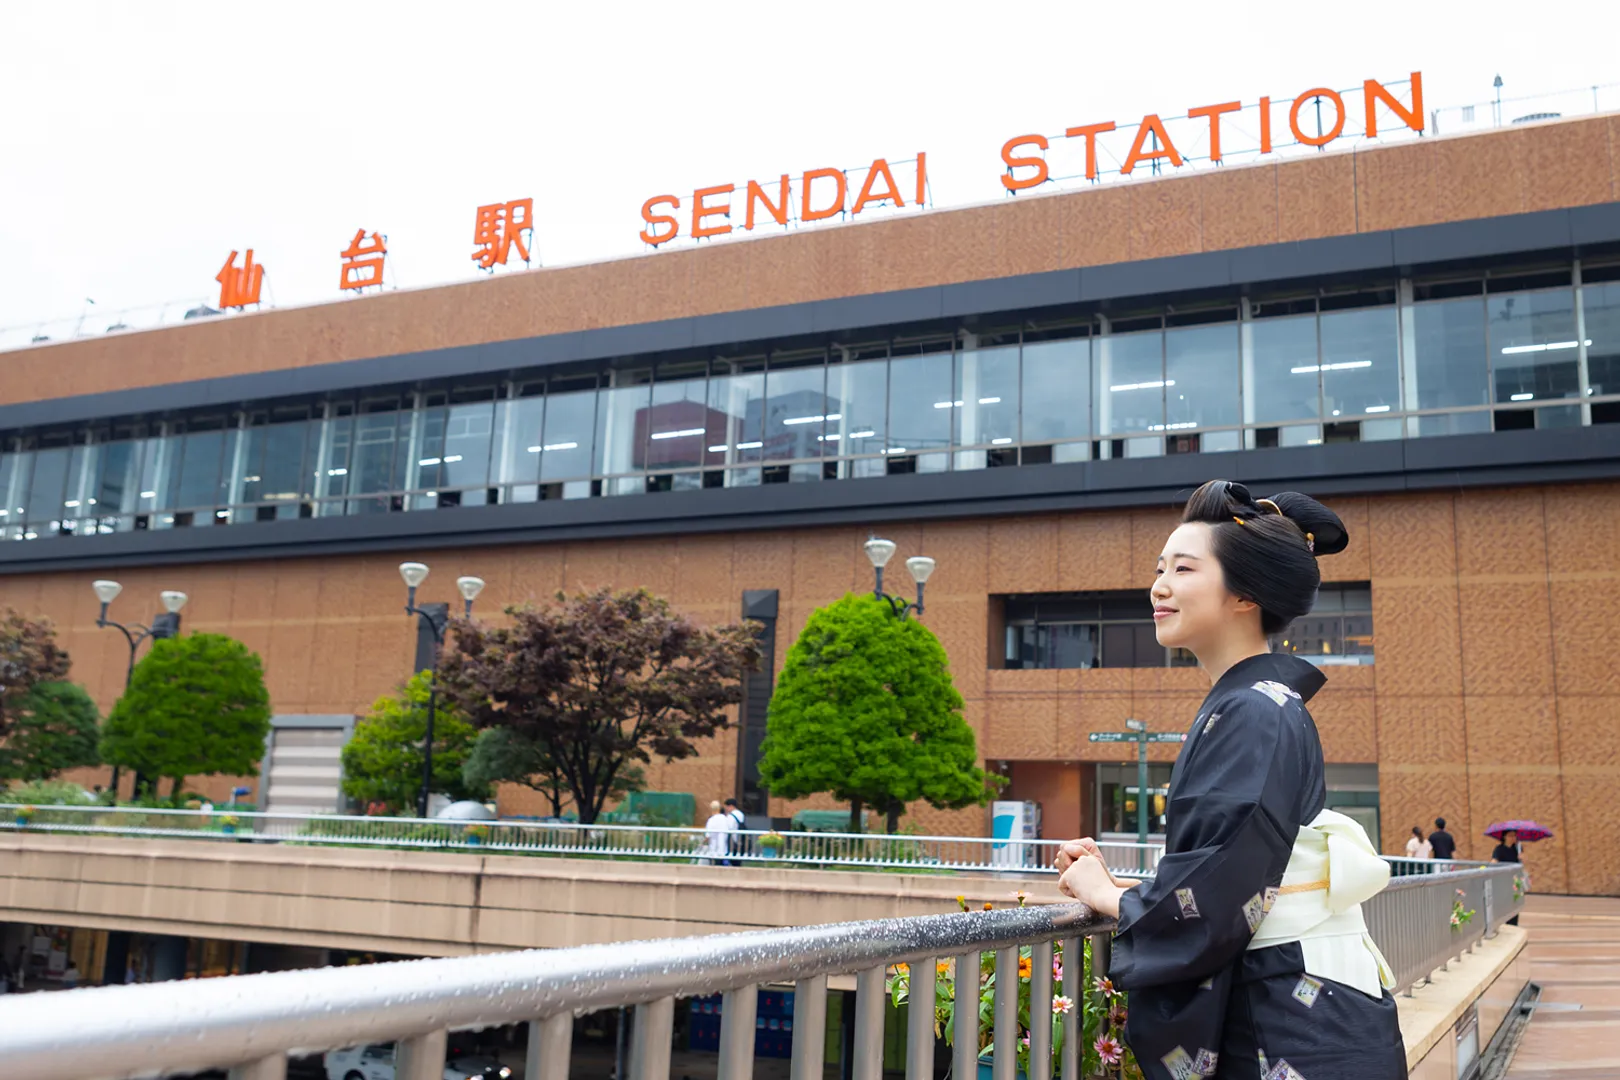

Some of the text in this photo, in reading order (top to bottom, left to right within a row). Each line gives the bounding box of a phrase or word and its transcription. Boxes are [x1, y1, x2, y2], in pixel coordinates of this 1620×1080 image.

[640, 71, 1425, 245] SENDAI STATION
[216, 199, 532, 307] 仙台駅
